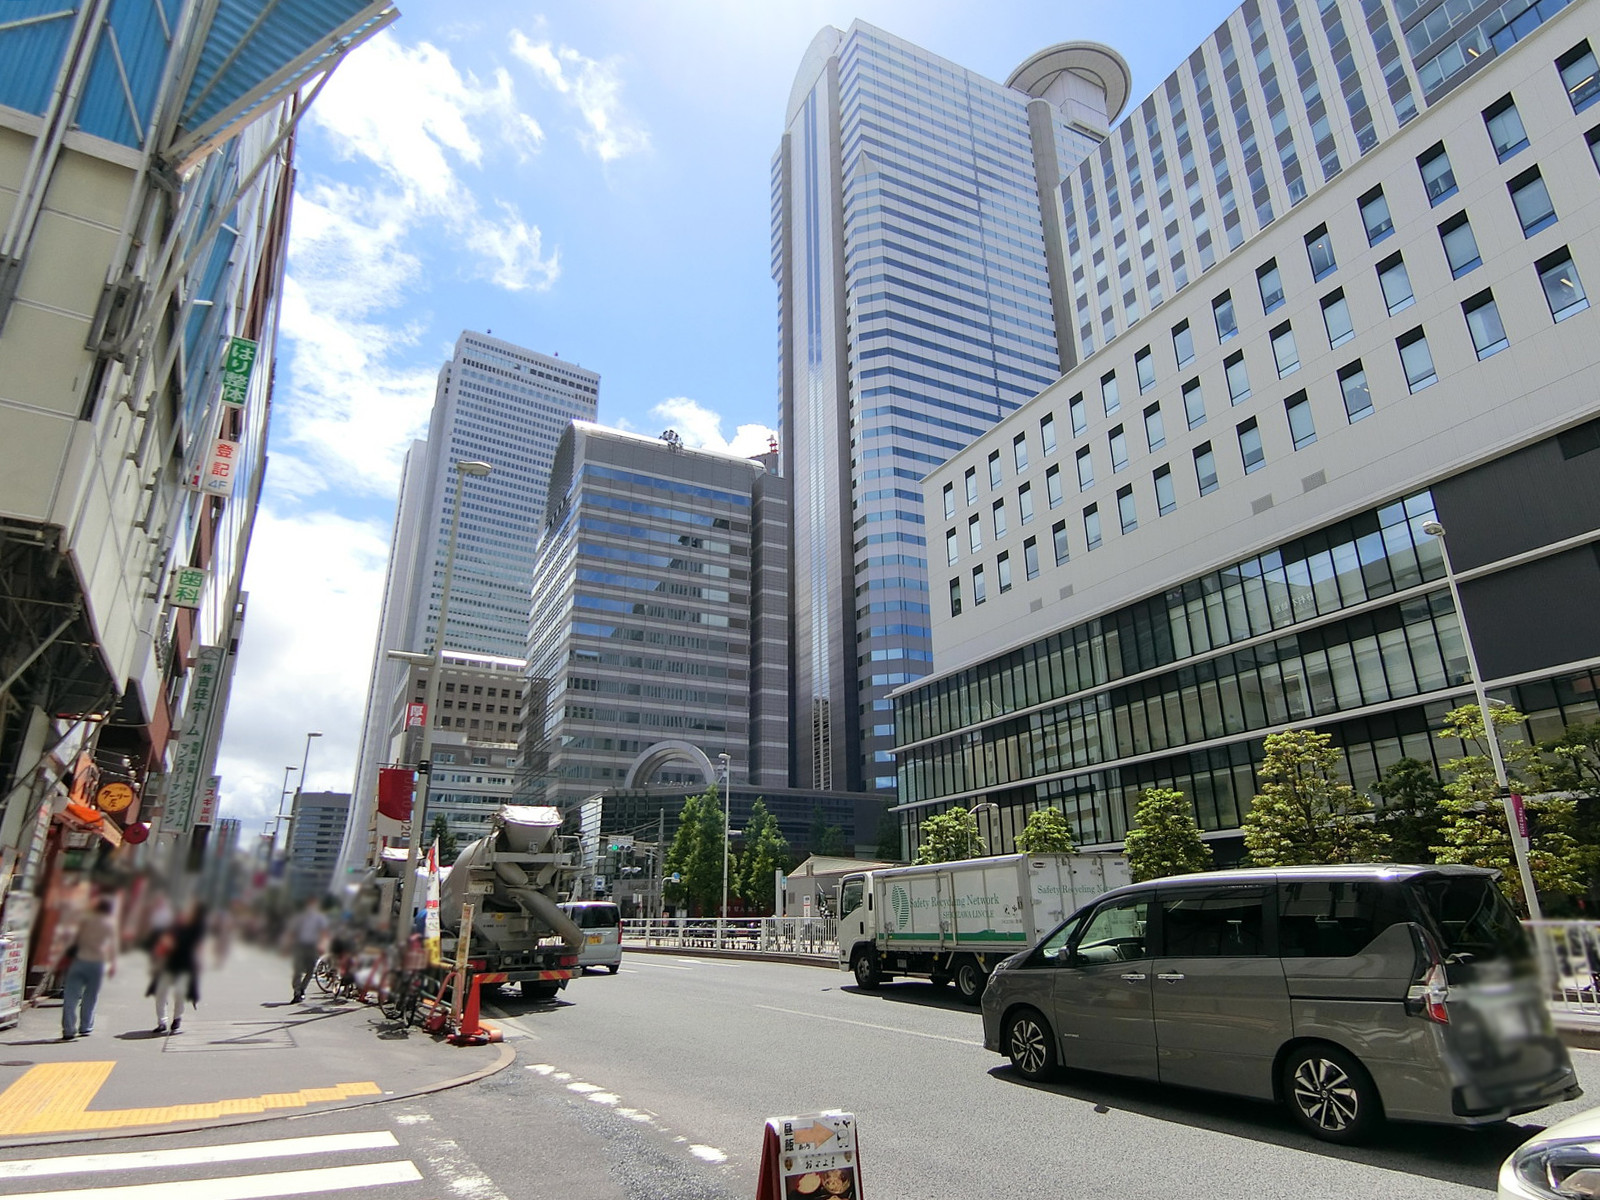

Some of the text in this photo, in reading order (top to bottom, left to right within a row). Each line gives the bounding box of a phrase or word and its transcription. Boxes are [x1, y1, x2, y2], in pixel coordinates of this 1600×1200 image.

[222, 344, 254, 402] はり整体
[212, 444, 233, 477] 登記
[208, 480, 228, 489] 4F
[175, 570, 204, 604] 歯科
[910, 897, 930, 909] Safety
[966, 893, 1000, 905] Network
[1037, 885, 1060, 895] Safety
